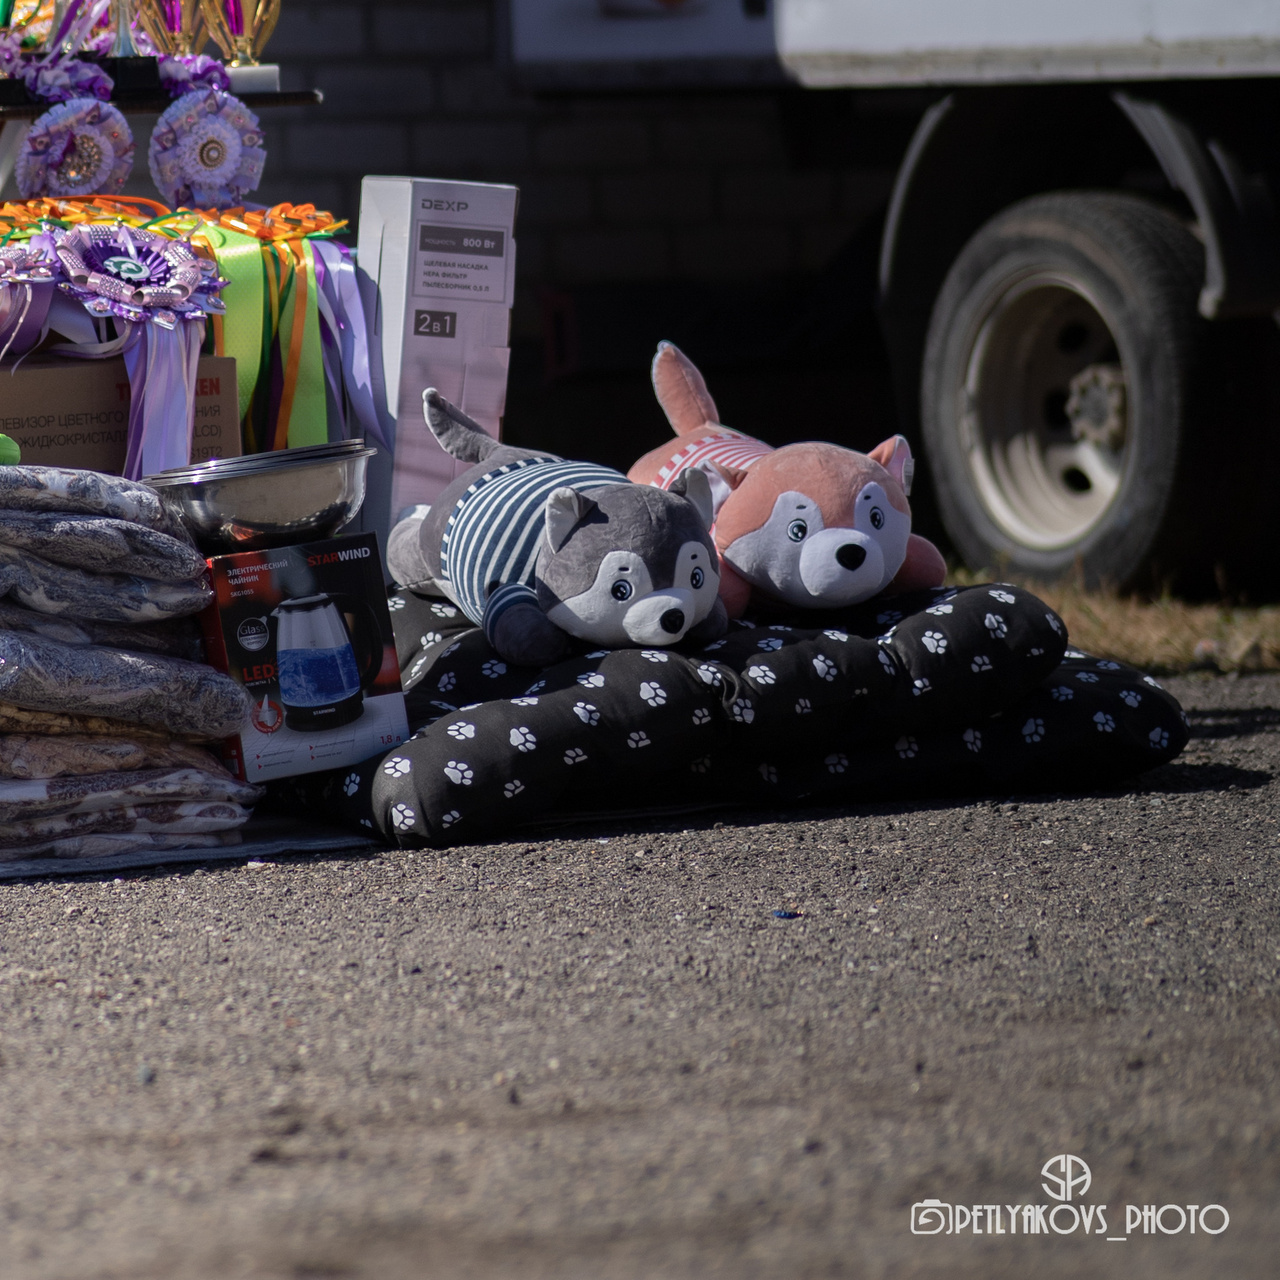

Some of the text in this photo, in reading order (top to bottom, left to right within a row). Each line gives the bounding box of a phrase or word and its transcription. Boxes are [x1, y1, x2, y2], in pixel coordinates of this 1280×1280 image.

[421, 199, 469, 212] DEXP
[463, 238, 482, 248] 800
[484, 240, 496, 249] Вт
[423, 260, 489, 271] ЩЕЛЕВАЯ НАСАДКА
[58, 410, 126, 429] ЦВЕТНОГО
[307, 547, 370, 567] STARWIND
[227, 559, 288, 577] ЭЛЕКТРИЧЕСКИЙ
[228, 574, 259, 586] ЧАЙНИК
[239, 625, 266, 636] Glass
[242, 663, 275, 682] LED
[379, 734, 393, 745] 1,8
